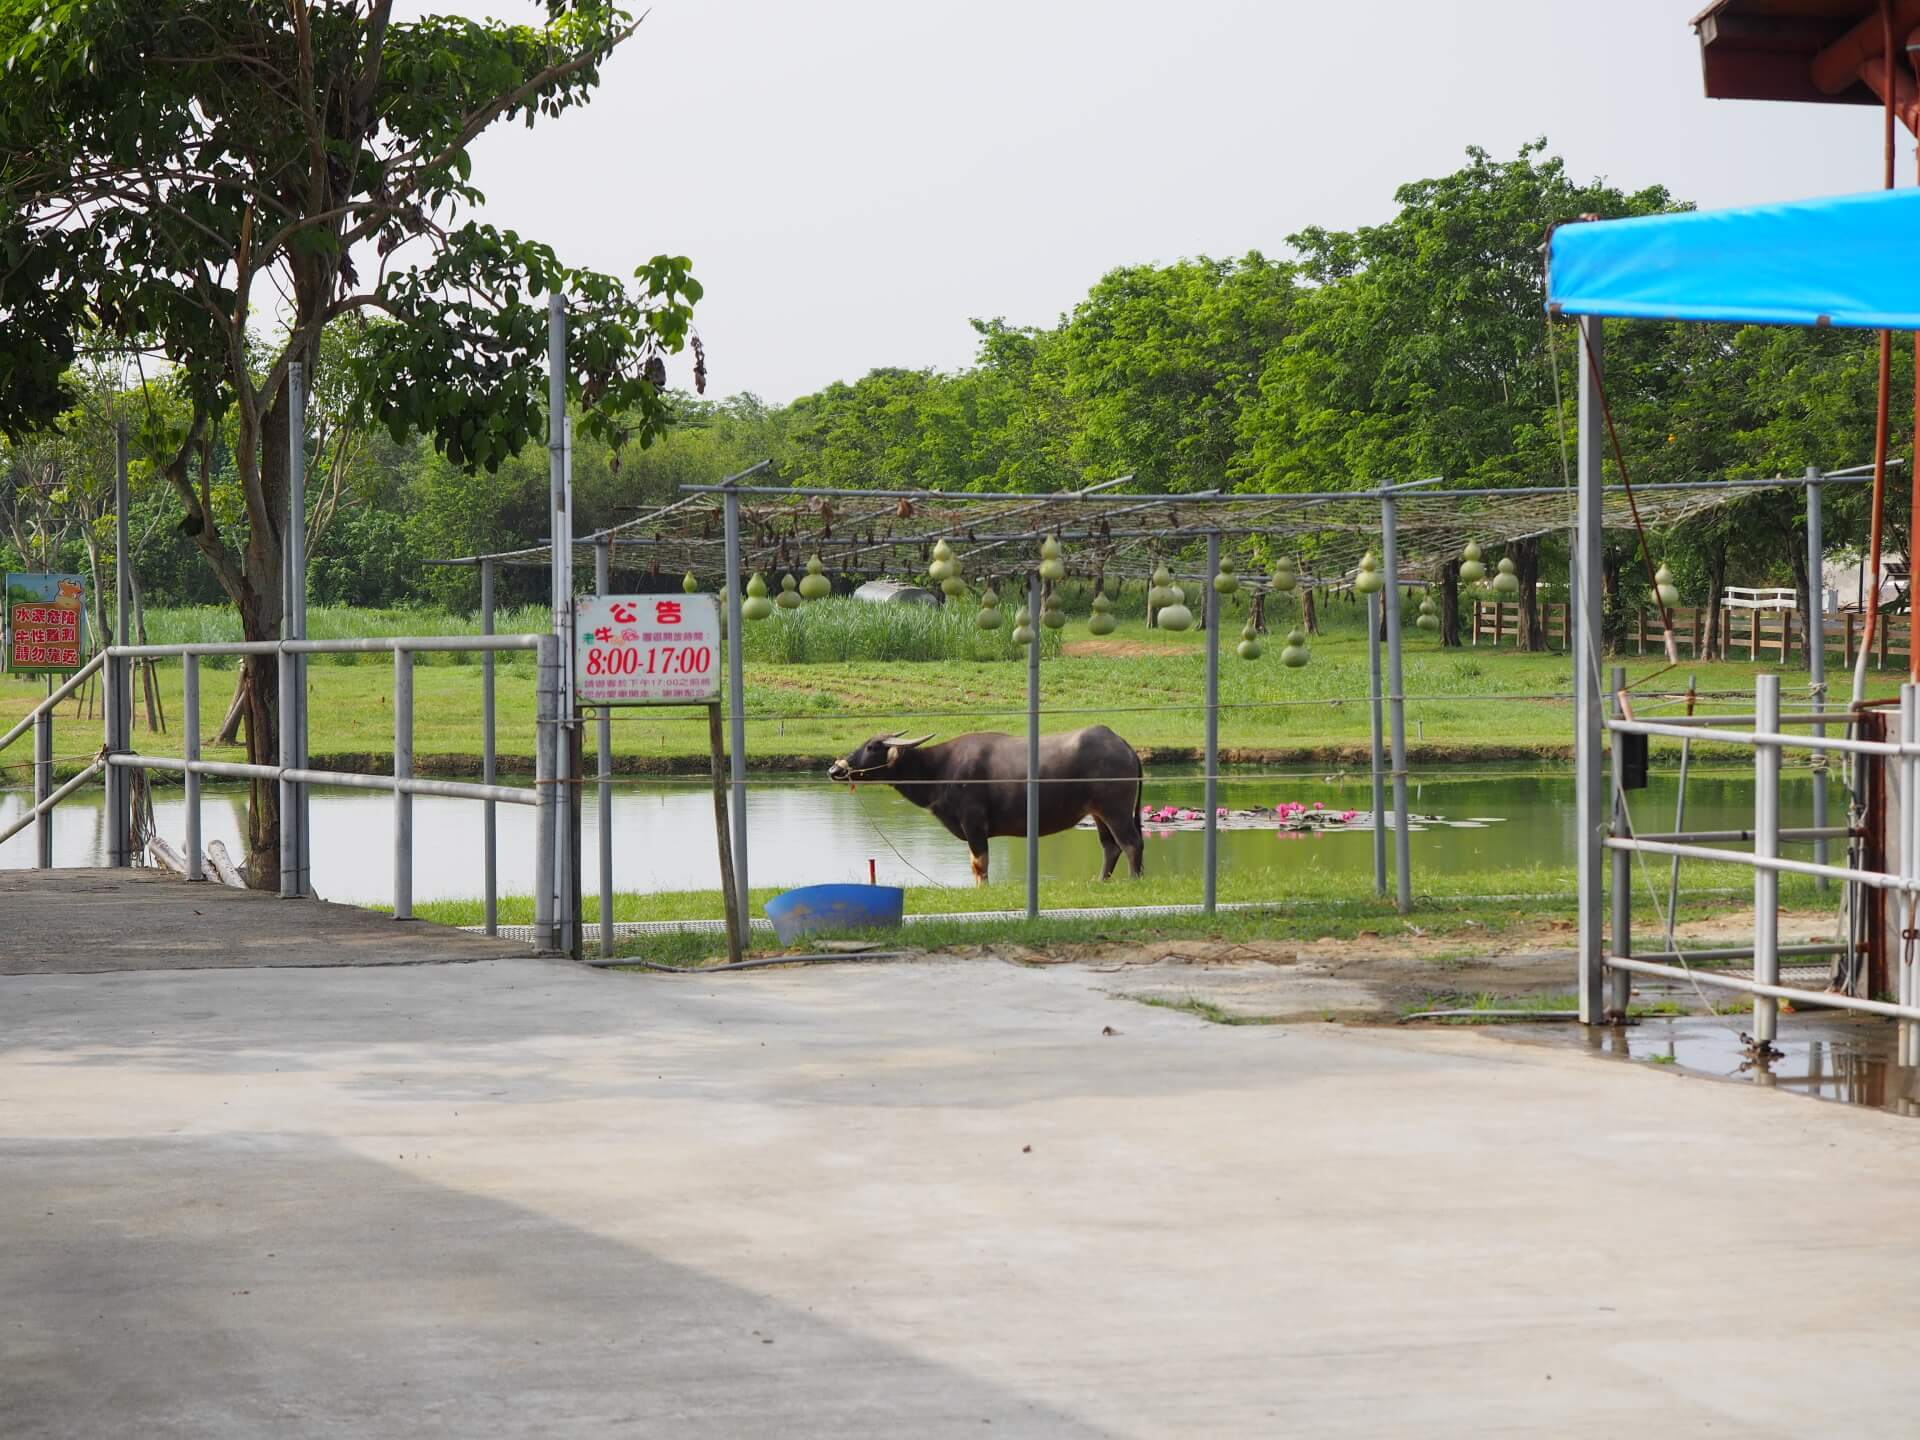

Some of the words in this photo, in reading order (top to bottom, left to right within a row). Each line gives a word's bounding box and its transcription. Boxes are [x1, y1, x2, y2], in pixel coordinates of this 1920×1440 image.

[16, 608, 76, 625] 水深危險
[609, 600, 682, 624] 公告
[15, 627, 75, 643] 牛性難測
[15, 645, 77, 664] 請勿靠近
[586, 647, 711, 676] 8:00-17:00
